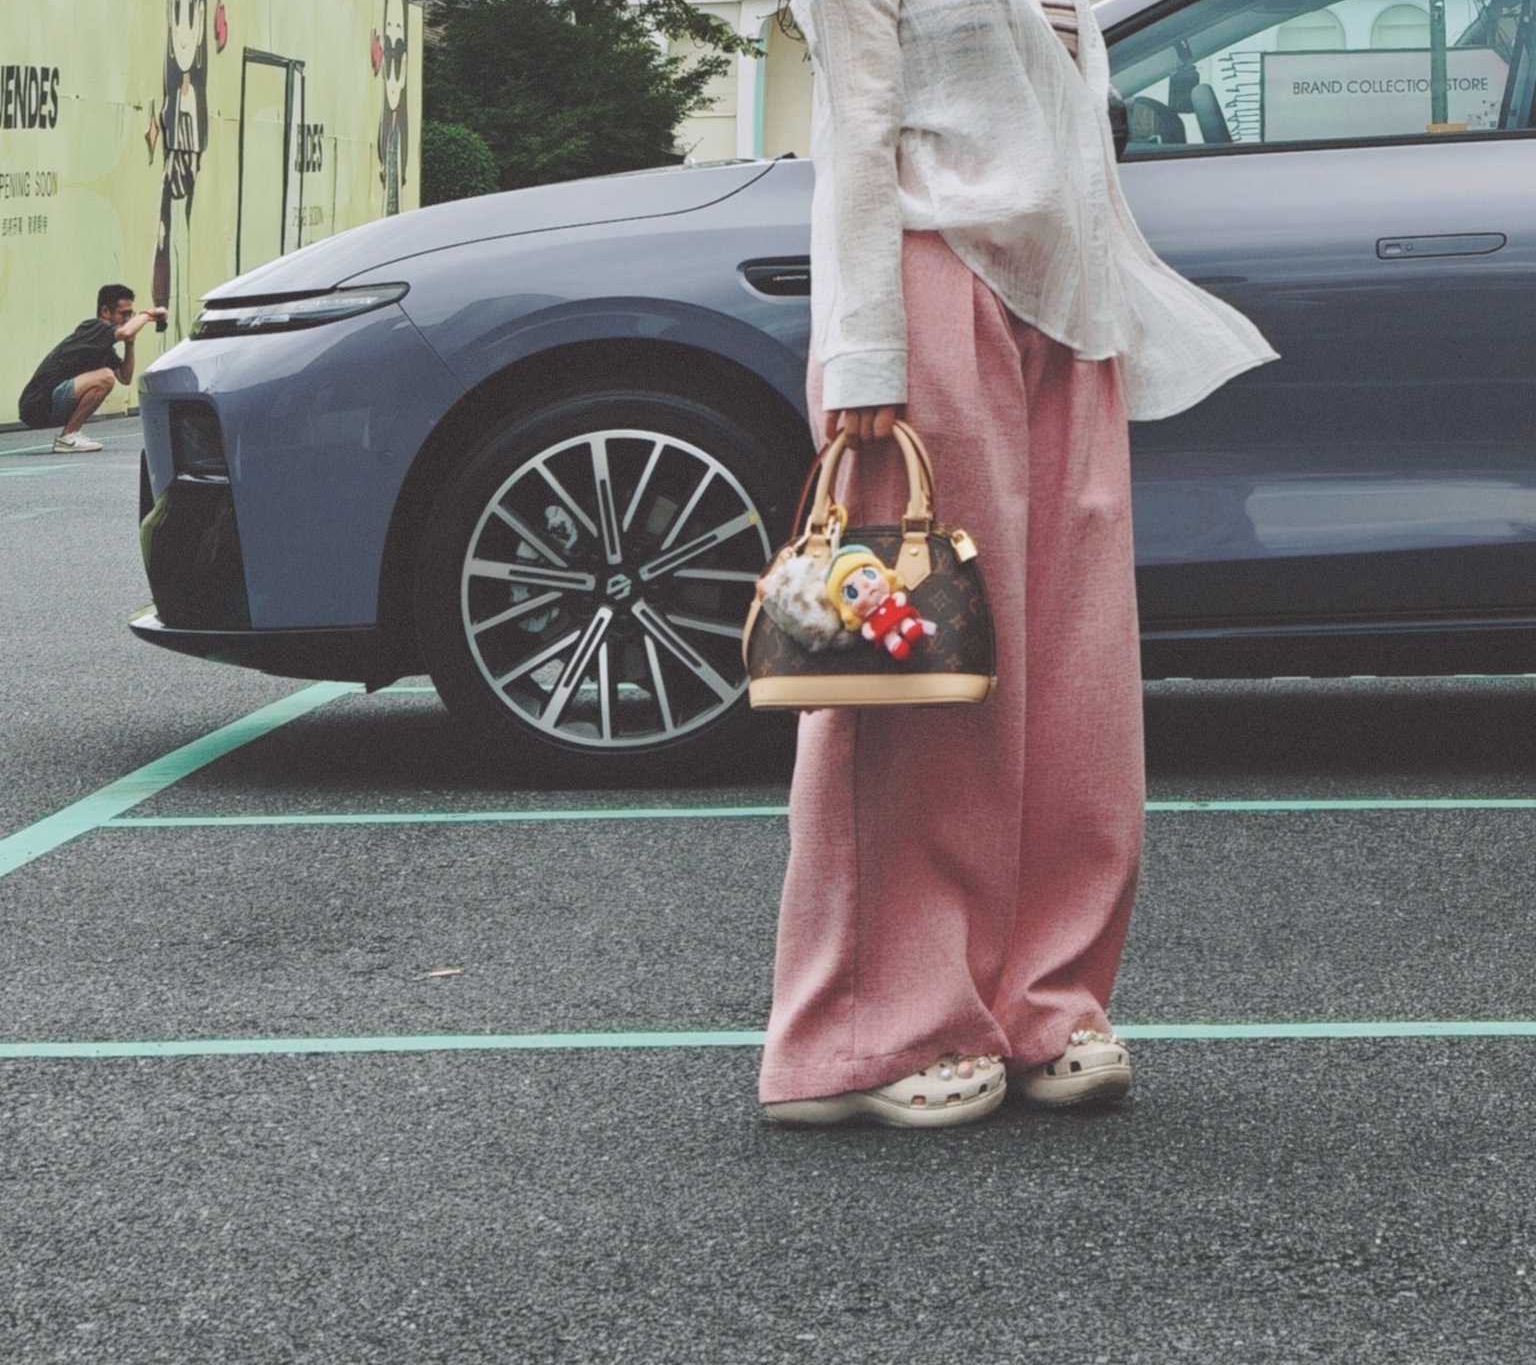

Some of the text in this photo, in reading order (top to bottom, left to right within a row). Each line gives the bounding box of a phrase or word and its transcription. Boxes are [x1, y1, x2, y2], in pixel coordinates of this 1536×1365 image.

[1293, 77, 1489, 95] BRAND COLLECTIO STORE
[34, 171, 59, 197] SOON
